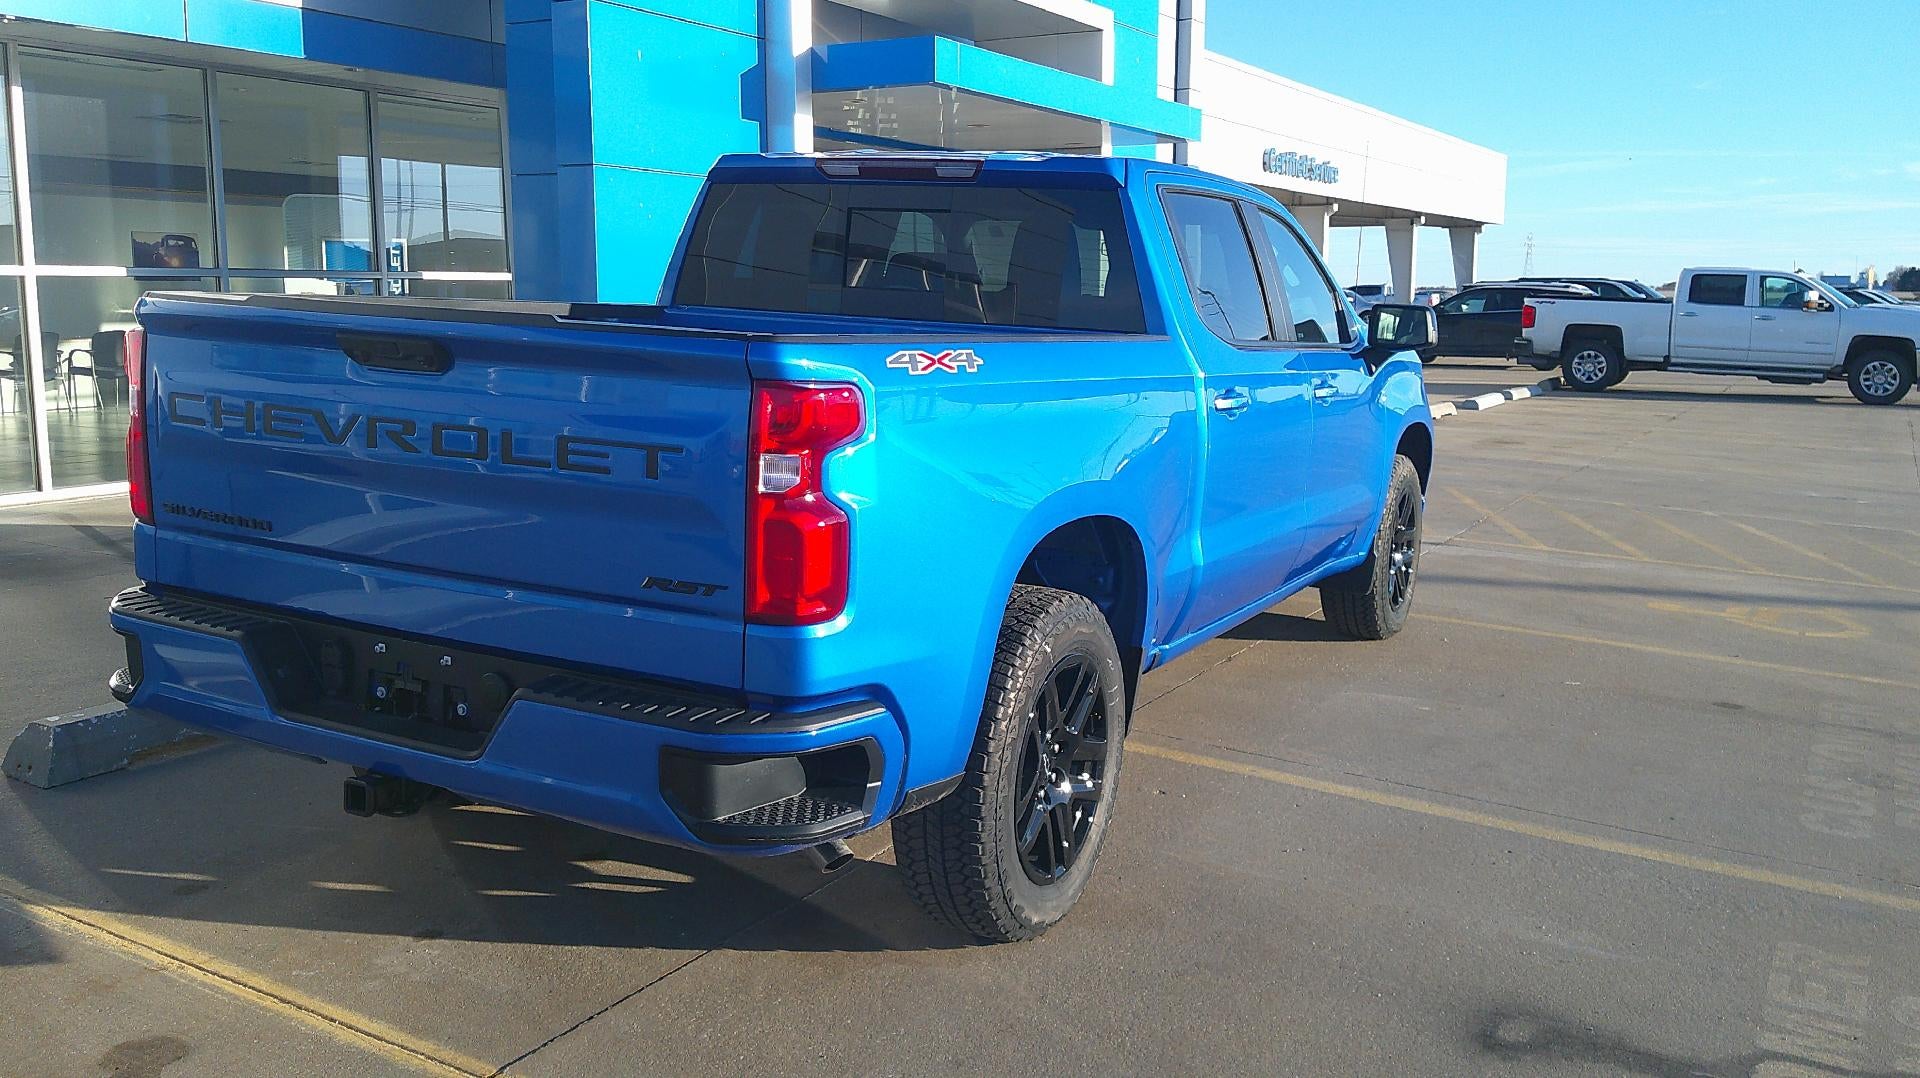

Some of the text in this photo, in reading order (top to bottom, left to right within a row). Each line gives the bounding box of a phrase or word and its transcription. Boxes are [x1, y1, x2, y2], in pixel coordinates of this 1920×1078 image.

[168, 392, 684, 480] CHEVROLET
[163, 502, 273, 532] SILVERADO
[641, 577, 729, 596] RST
